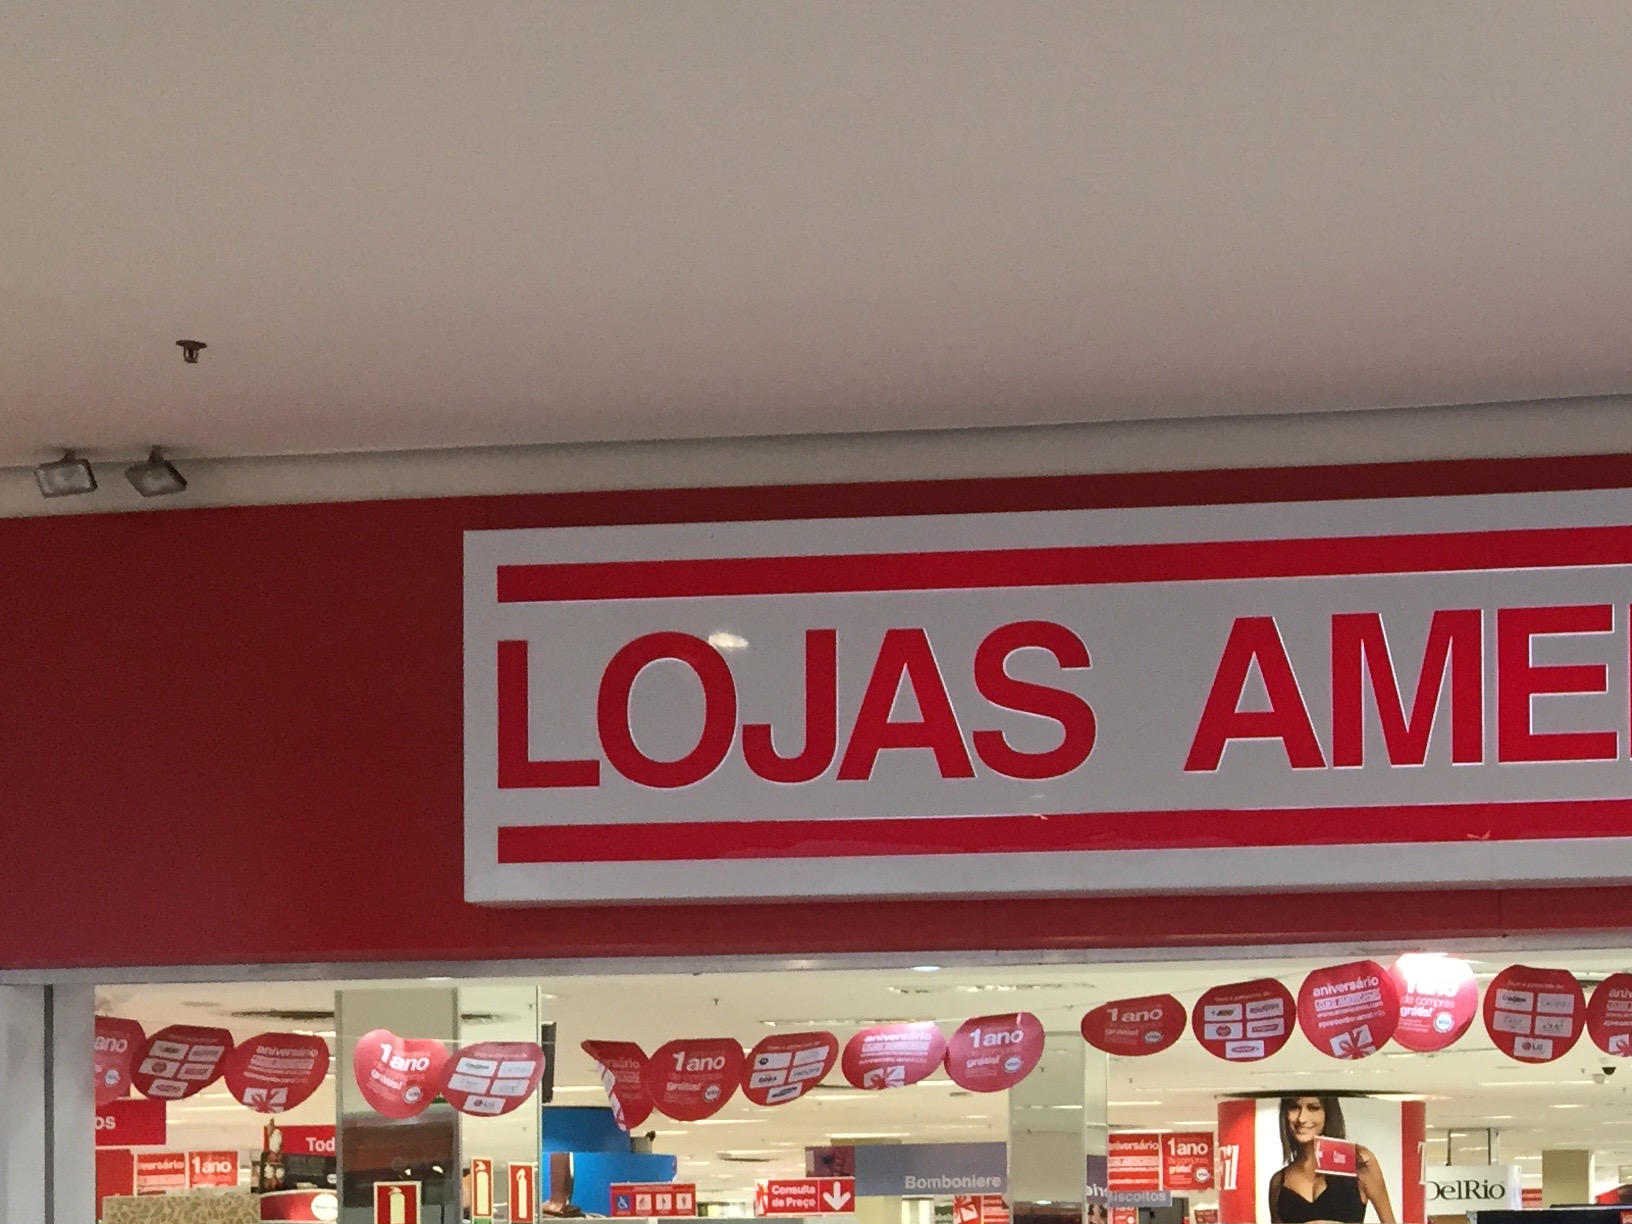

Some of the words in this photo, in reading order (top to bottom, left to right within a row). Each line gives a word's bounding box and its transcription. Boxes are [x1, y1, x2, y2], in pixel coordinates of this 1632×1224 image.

[496, 619, 1097, 789] LOJAS
[1312, 976, 1379, 997] aniversário
[1106, 1007, 1119, 1023] 1
[1121, 1007, 1164, 1023] ano
[969, 1028, 983, 1049] 1
[983, 1029, 1025, 1048] ano
[379, 1042, 394, 1064] 1
[390, 1054, 431, 1072] ano
[672, 1052, 686, 1072] 1
[687, 1055, 726, 1071] ano
[305, 1136, 336, 1152] Tod
[1167, 1137, 1178, 1156] 1
[1178, 1141, 1209, 1155] ano
[202, 1160, 232, 1174] ano
[771, 1184, 817, 1196] Consulta
[904, 1174, 1002, 1190] Bomboniere
[771, 1196, 785, 1208] de
[785, 1196, 817, 1209] Preço
